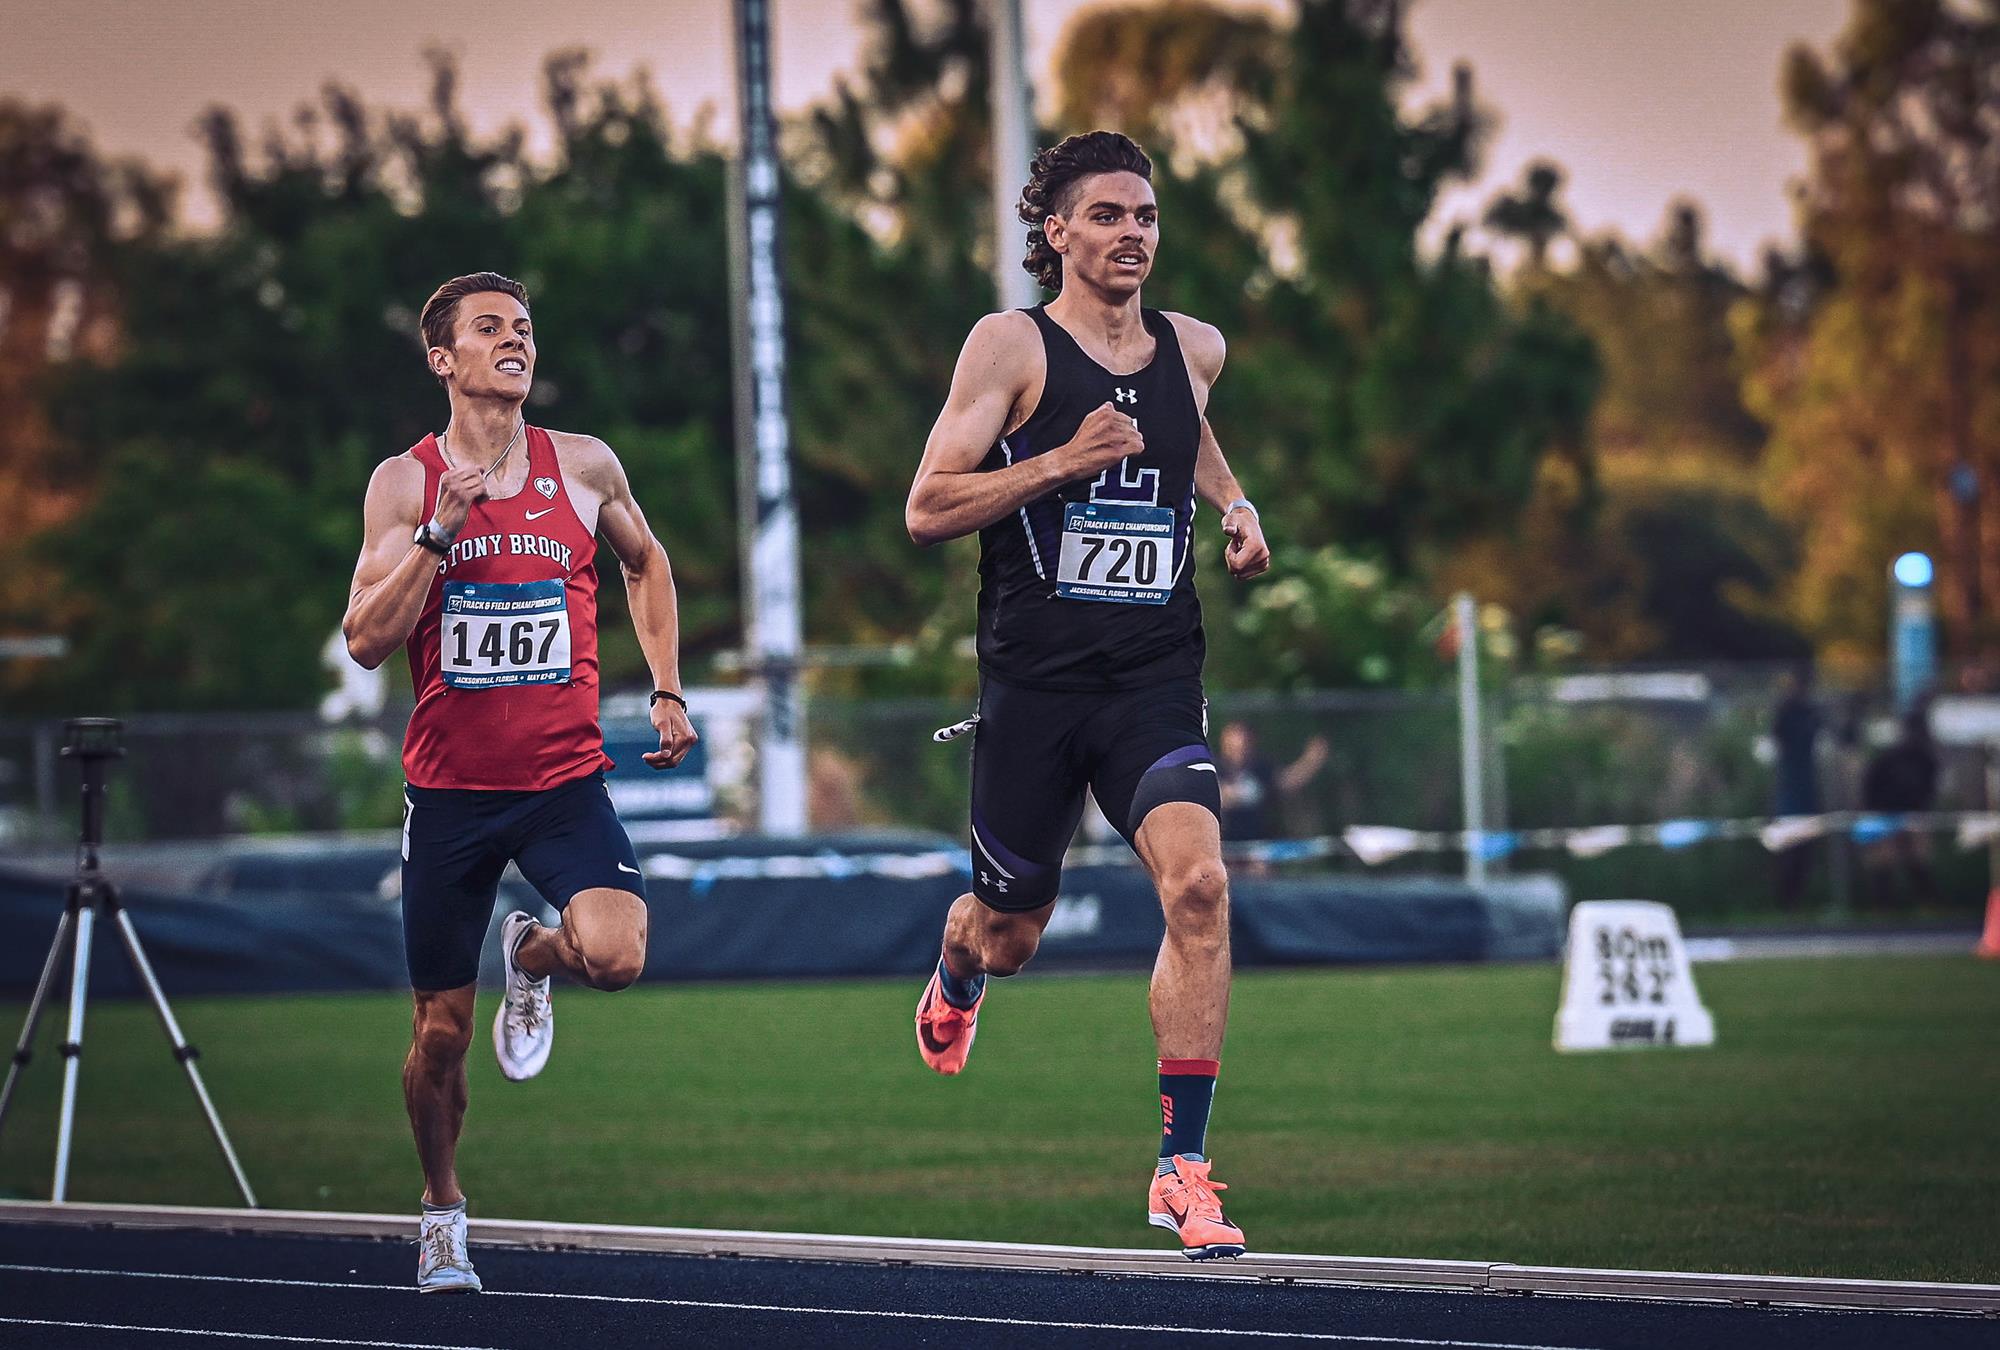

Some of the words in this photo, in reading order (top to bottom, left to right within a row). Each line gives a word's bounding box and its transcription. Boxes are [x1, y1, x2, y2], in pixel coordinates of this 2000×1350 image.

[1083, 520, 1104, 529] TRACK
[1108, 522, 1125, 530] FIELD
[1125, 522, 1170, 533] CHAMPIONSHIPS
[509, 534, 572, 572] BROOK
[1077, 537, 1158, 585] 720
[1107, 589, 1129, 598] FLORIDA
[462, 600, 485, 609] TRACK
[491, 601, 511, 610] FIELD
[511, 597, 562, 610] CHAMPIONSHIPS
[452, 618, 560, 667] 1467
[495, 675, 518, 683] FLORIDA
[527, 673, 540, 681] MAY
